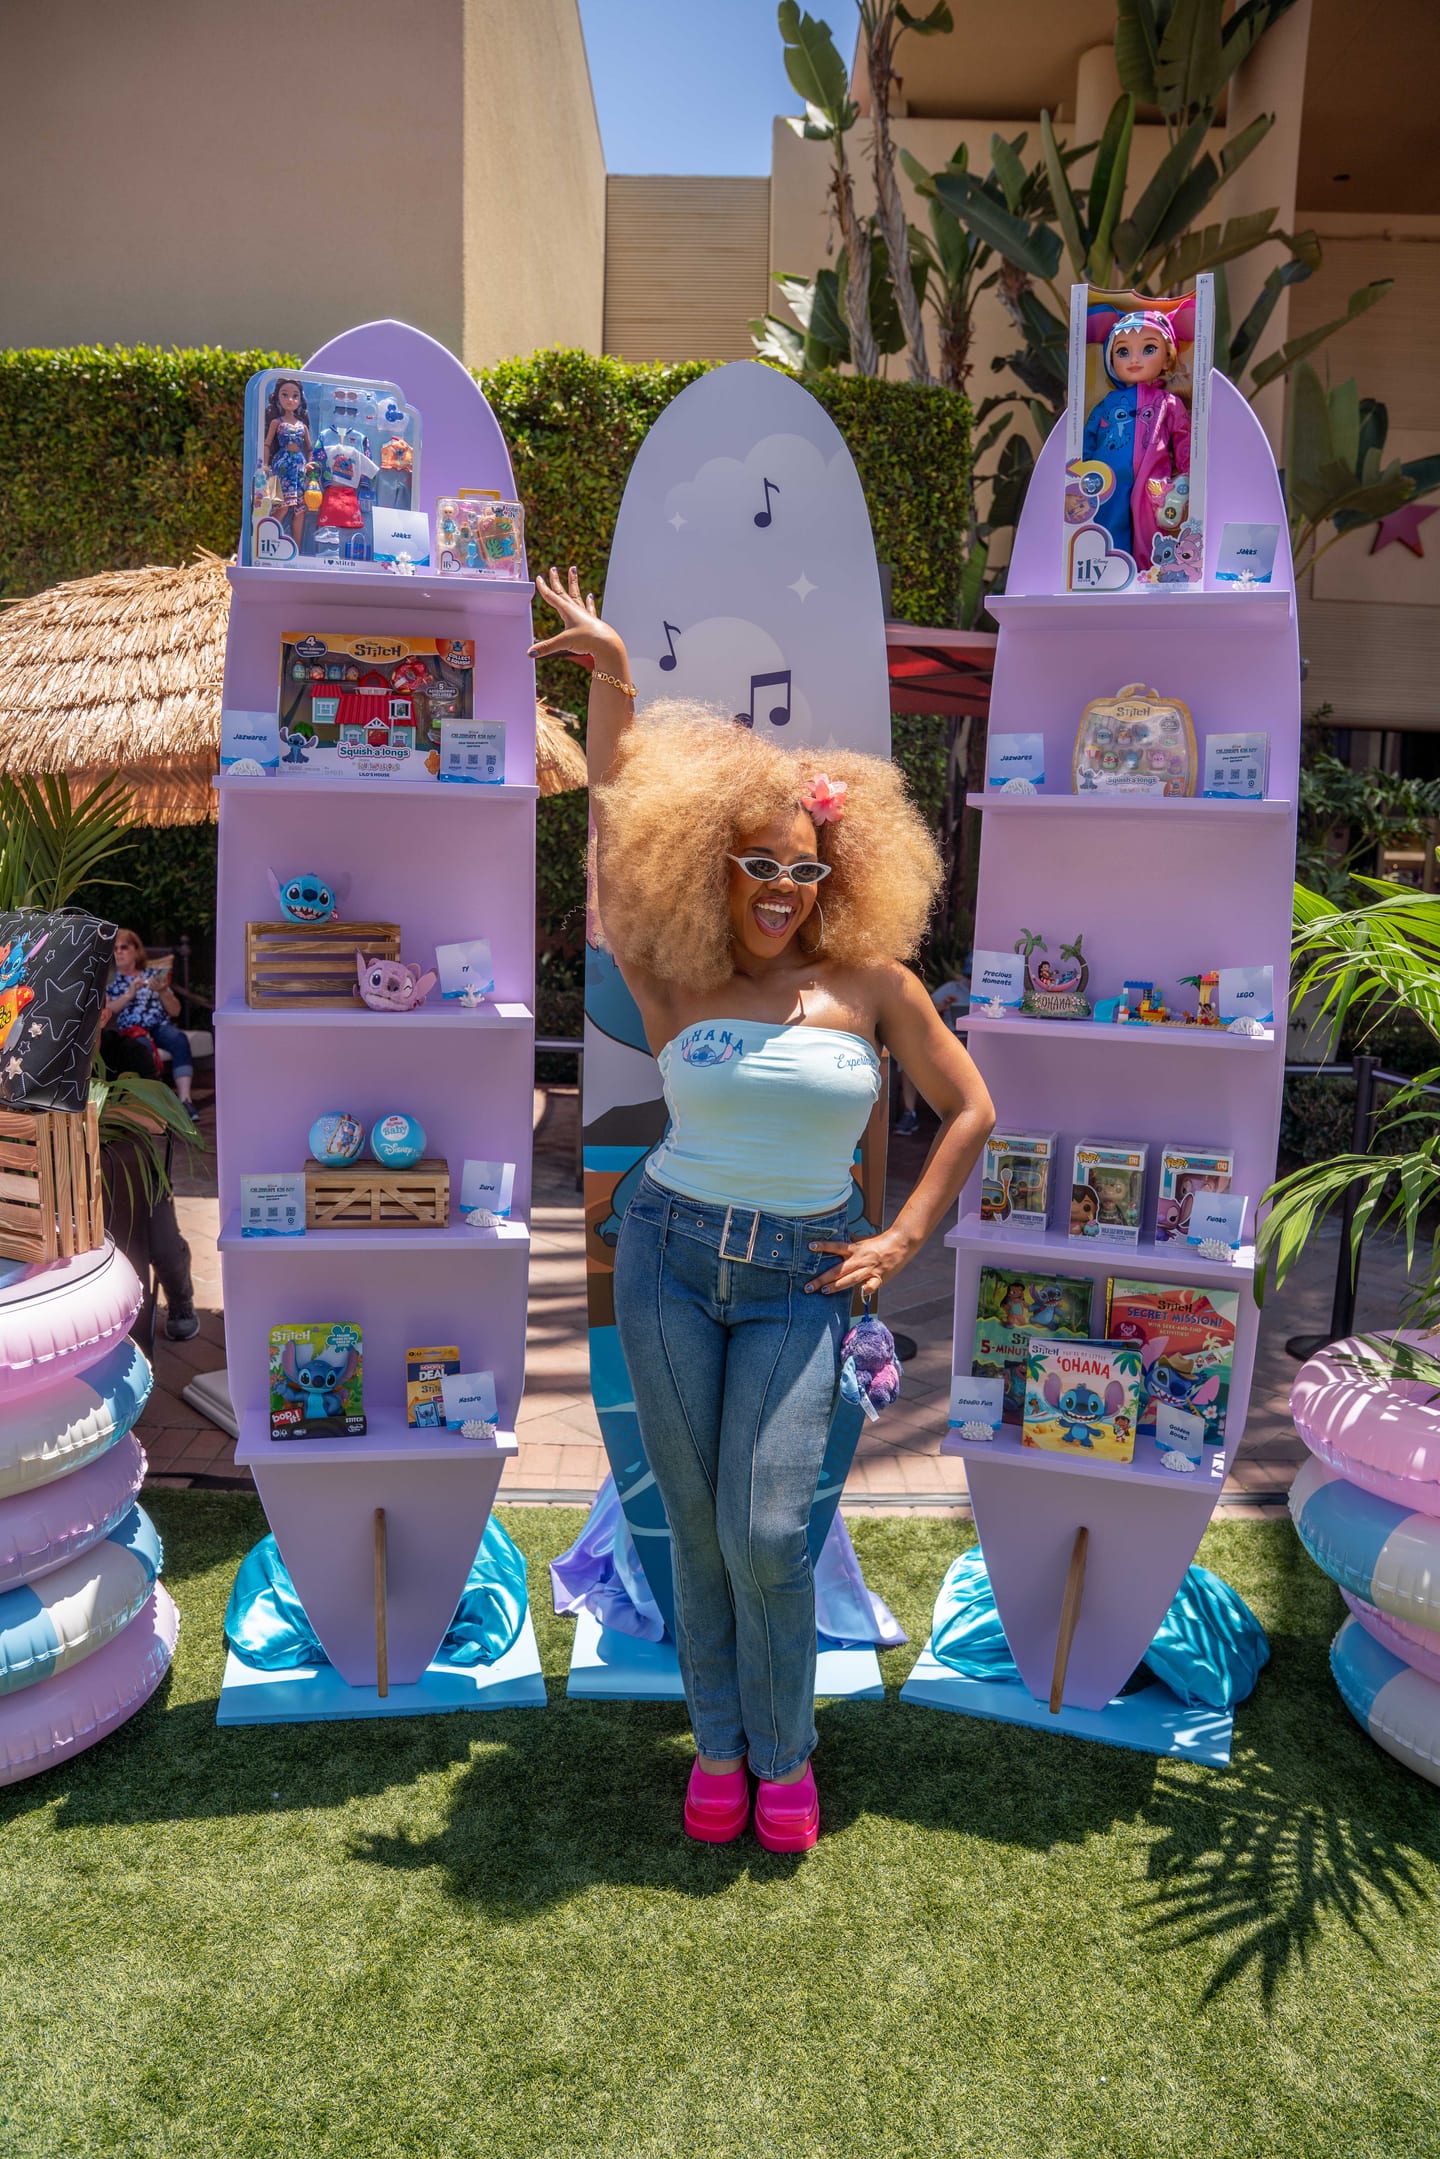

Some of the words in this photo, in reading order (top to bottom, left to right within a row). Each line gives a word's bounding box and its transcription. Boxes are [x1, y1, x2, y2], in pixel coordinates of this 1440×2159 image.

[261, 539, 279, 556] ily
[1077, 559, 1107, 586] ily
[306, 636, 316, 646] 4
[233, 733, 268, 741] Jazwares
[983, 970, 1012, 979] Precious
[981, 978, 1012, 986] Moments
[1041, 996, 1071, 1010] OHANA
[383, 1125, 407, 1135] Baby
[380, 1143, 413, 1156] Disney
[988, 1141, 1009, 1152] POP!
[1078, 1152, 1100, 1164] POP!
[1164, 1157, 1188, 1169] POP!
[1127, 1307, 1168, 1320] SECRET
[1172, 1314, 1224, 1328] MISSION!
[980, 1339, 1028, 1356] 5-MINUT
[419, 1369, 447, 1381] DEAL
[272, 1411, 292, 1423] bop
[1169, 1424, 1190, 1435] Golden
[1170, 1431, 1188, 1440] Books
